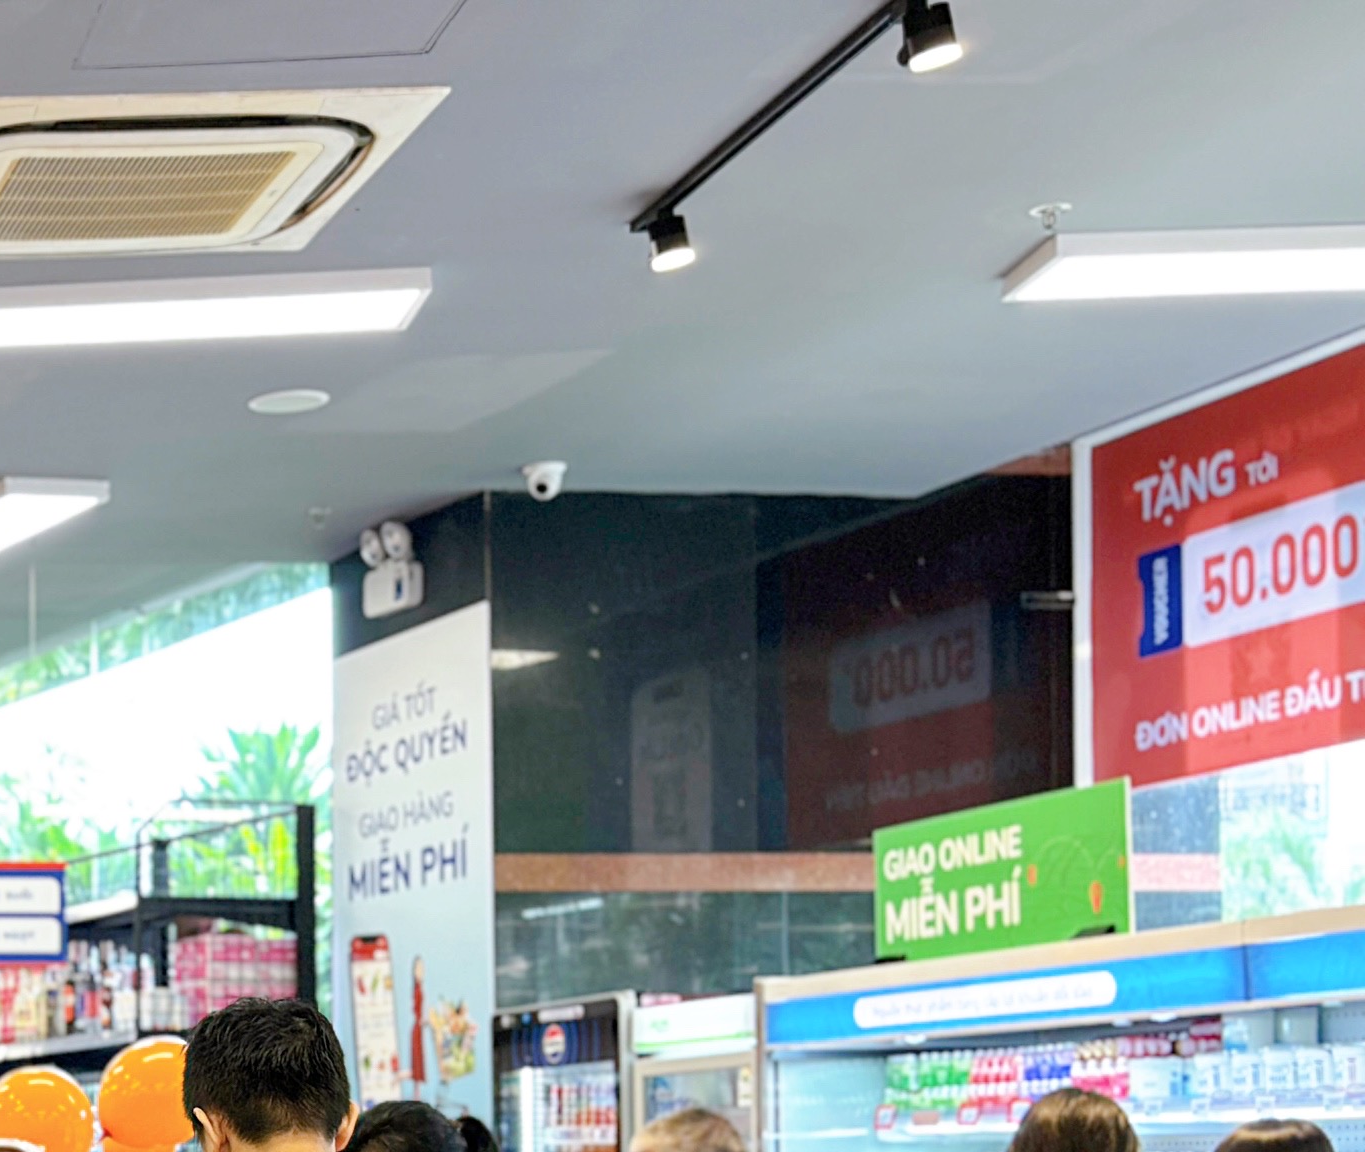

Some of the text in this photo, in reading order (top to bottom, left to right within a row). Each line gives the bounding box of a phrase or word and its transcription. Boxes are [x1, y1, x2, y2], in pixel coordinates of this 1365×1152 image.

[1133, 449, 1235, 527] TẶNG
[371, 679, 436, 730] GIÁ TỐT
[1135, 711, 1188, 750] ĐƠN
[1192, 692, 1281, 737] ONLINE
[346, 740, 389, 787] ĐỘC
[358, 790, 454, 839] GIAO HÀNG
[348, 822, 470, 903] MIỄN PHÍ
[883, 825, 1023, 881] GIAO ONLINE
[886, 868, 1023, 944] MIỄN PHÍ
